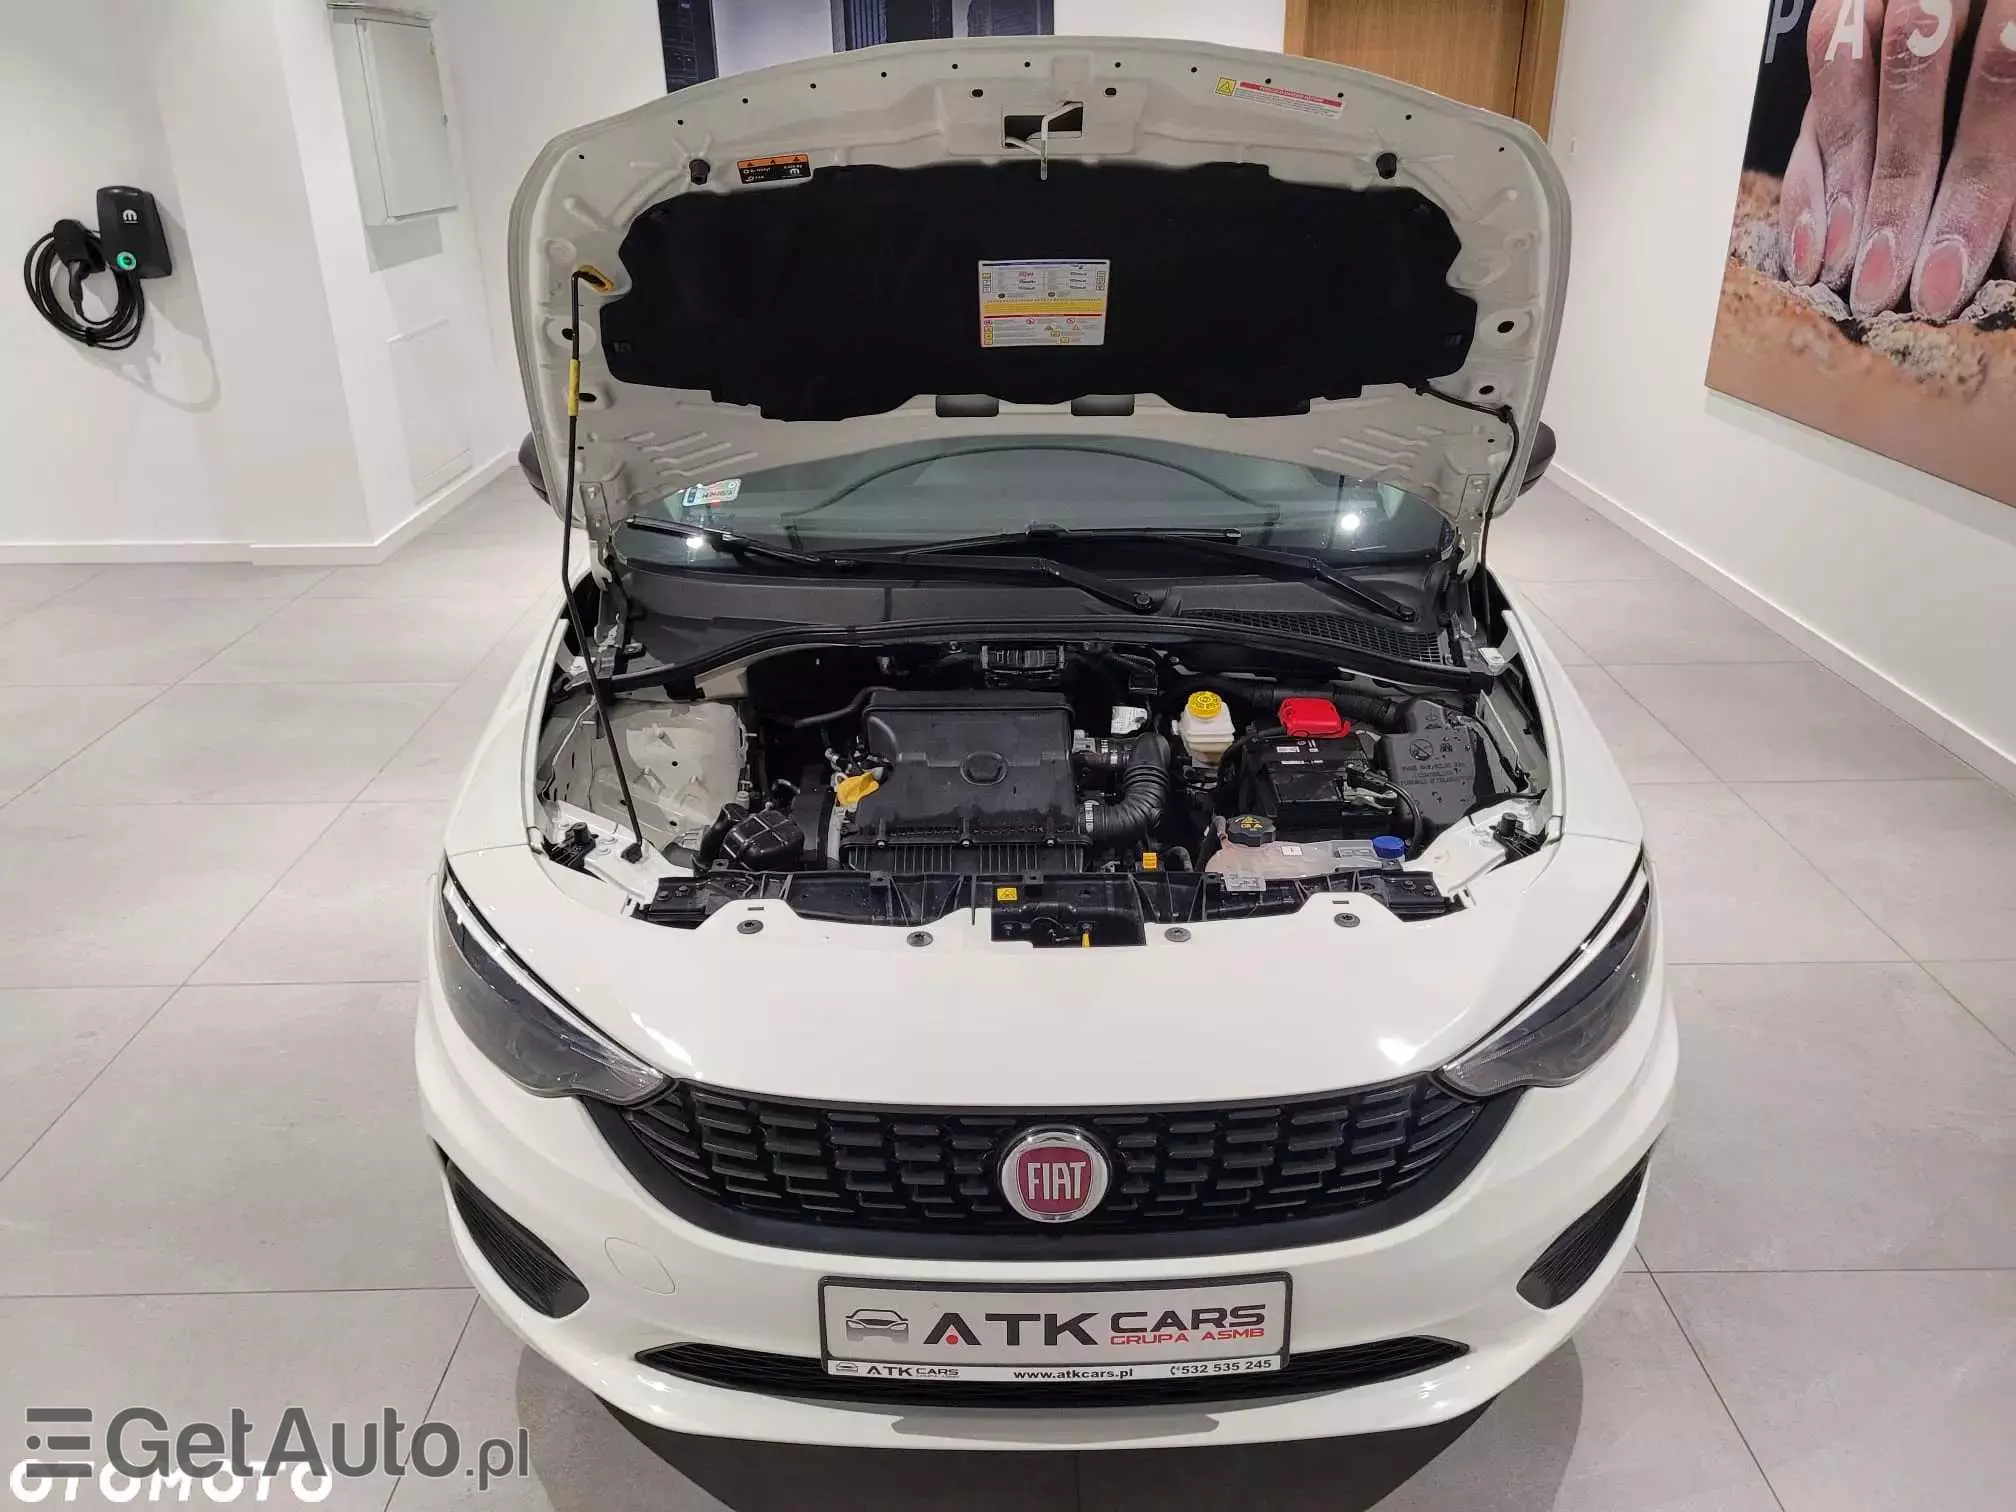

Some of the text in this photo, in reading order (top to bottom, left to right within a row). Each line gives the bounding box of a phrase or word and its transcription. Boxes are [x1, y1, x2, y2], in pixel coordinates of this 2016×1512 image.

[1027, 1161, 1087, 1201] FIAT
[923, 1303, 1267, 1346] ATK CARS
[1110, 1327, 1265, 1346] GRUPA ASMB
[866, 1365, 914, 1377] ATK
[916, 1367, 960, 1377] CARS
[1013, 1368, 1134, 1380] www.atkcars.pl
[1213, 1362, 1240, 1373] 535
[1245, 1359, 1273, 1370] 245
